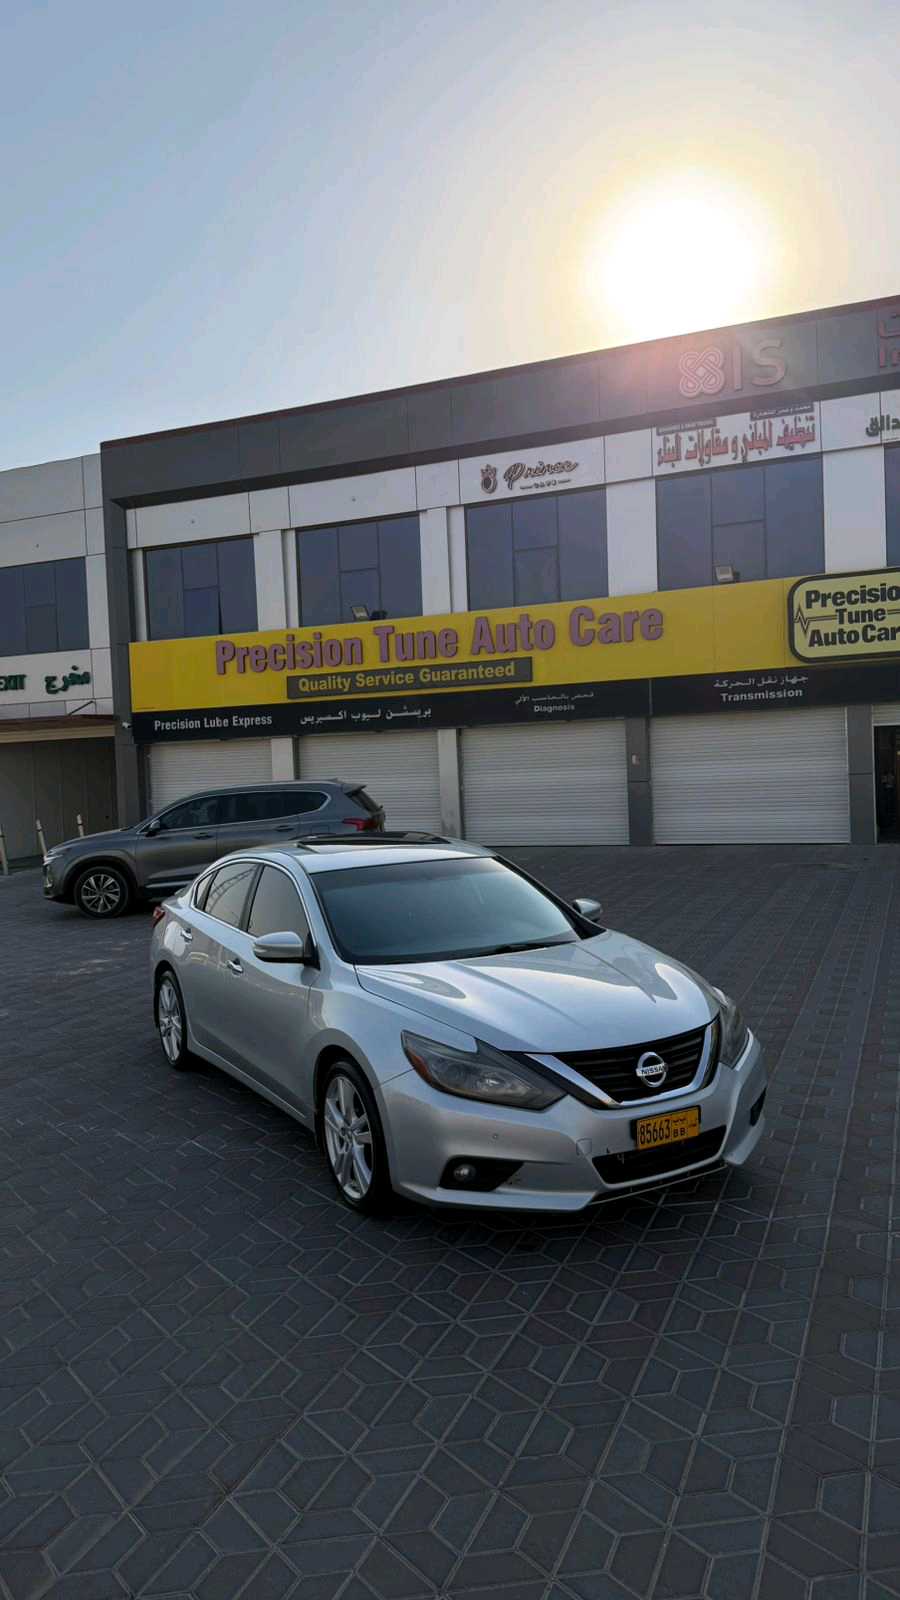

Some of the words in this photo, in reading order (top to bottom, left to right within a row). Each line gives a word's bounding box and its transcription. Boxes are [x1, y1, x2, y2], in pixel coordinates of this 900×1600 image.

[835, 607, 886, 625] Tune
[216, 632, 363, 675] Precision
[374, 625, 458, 663] Tune
[471, 614, 555, 656] Auto
[569, 606, 664, 647] Care
[44, 665, 90, 694] مخرج
[299, 677, 351, 692] Quality
[355, 671, 414, 688] Service
[419, 662, 515, 682] Guaranteed
[720, 688, 803, 702] Transmission
[533, 704, 575, 713] Diagnosis
[154, 718, 200, 730] Precision
[204, 716, 229, 728] Lube
[232, 715, 273, 728] Express
[639, 1119, 671, 1145] 85663
